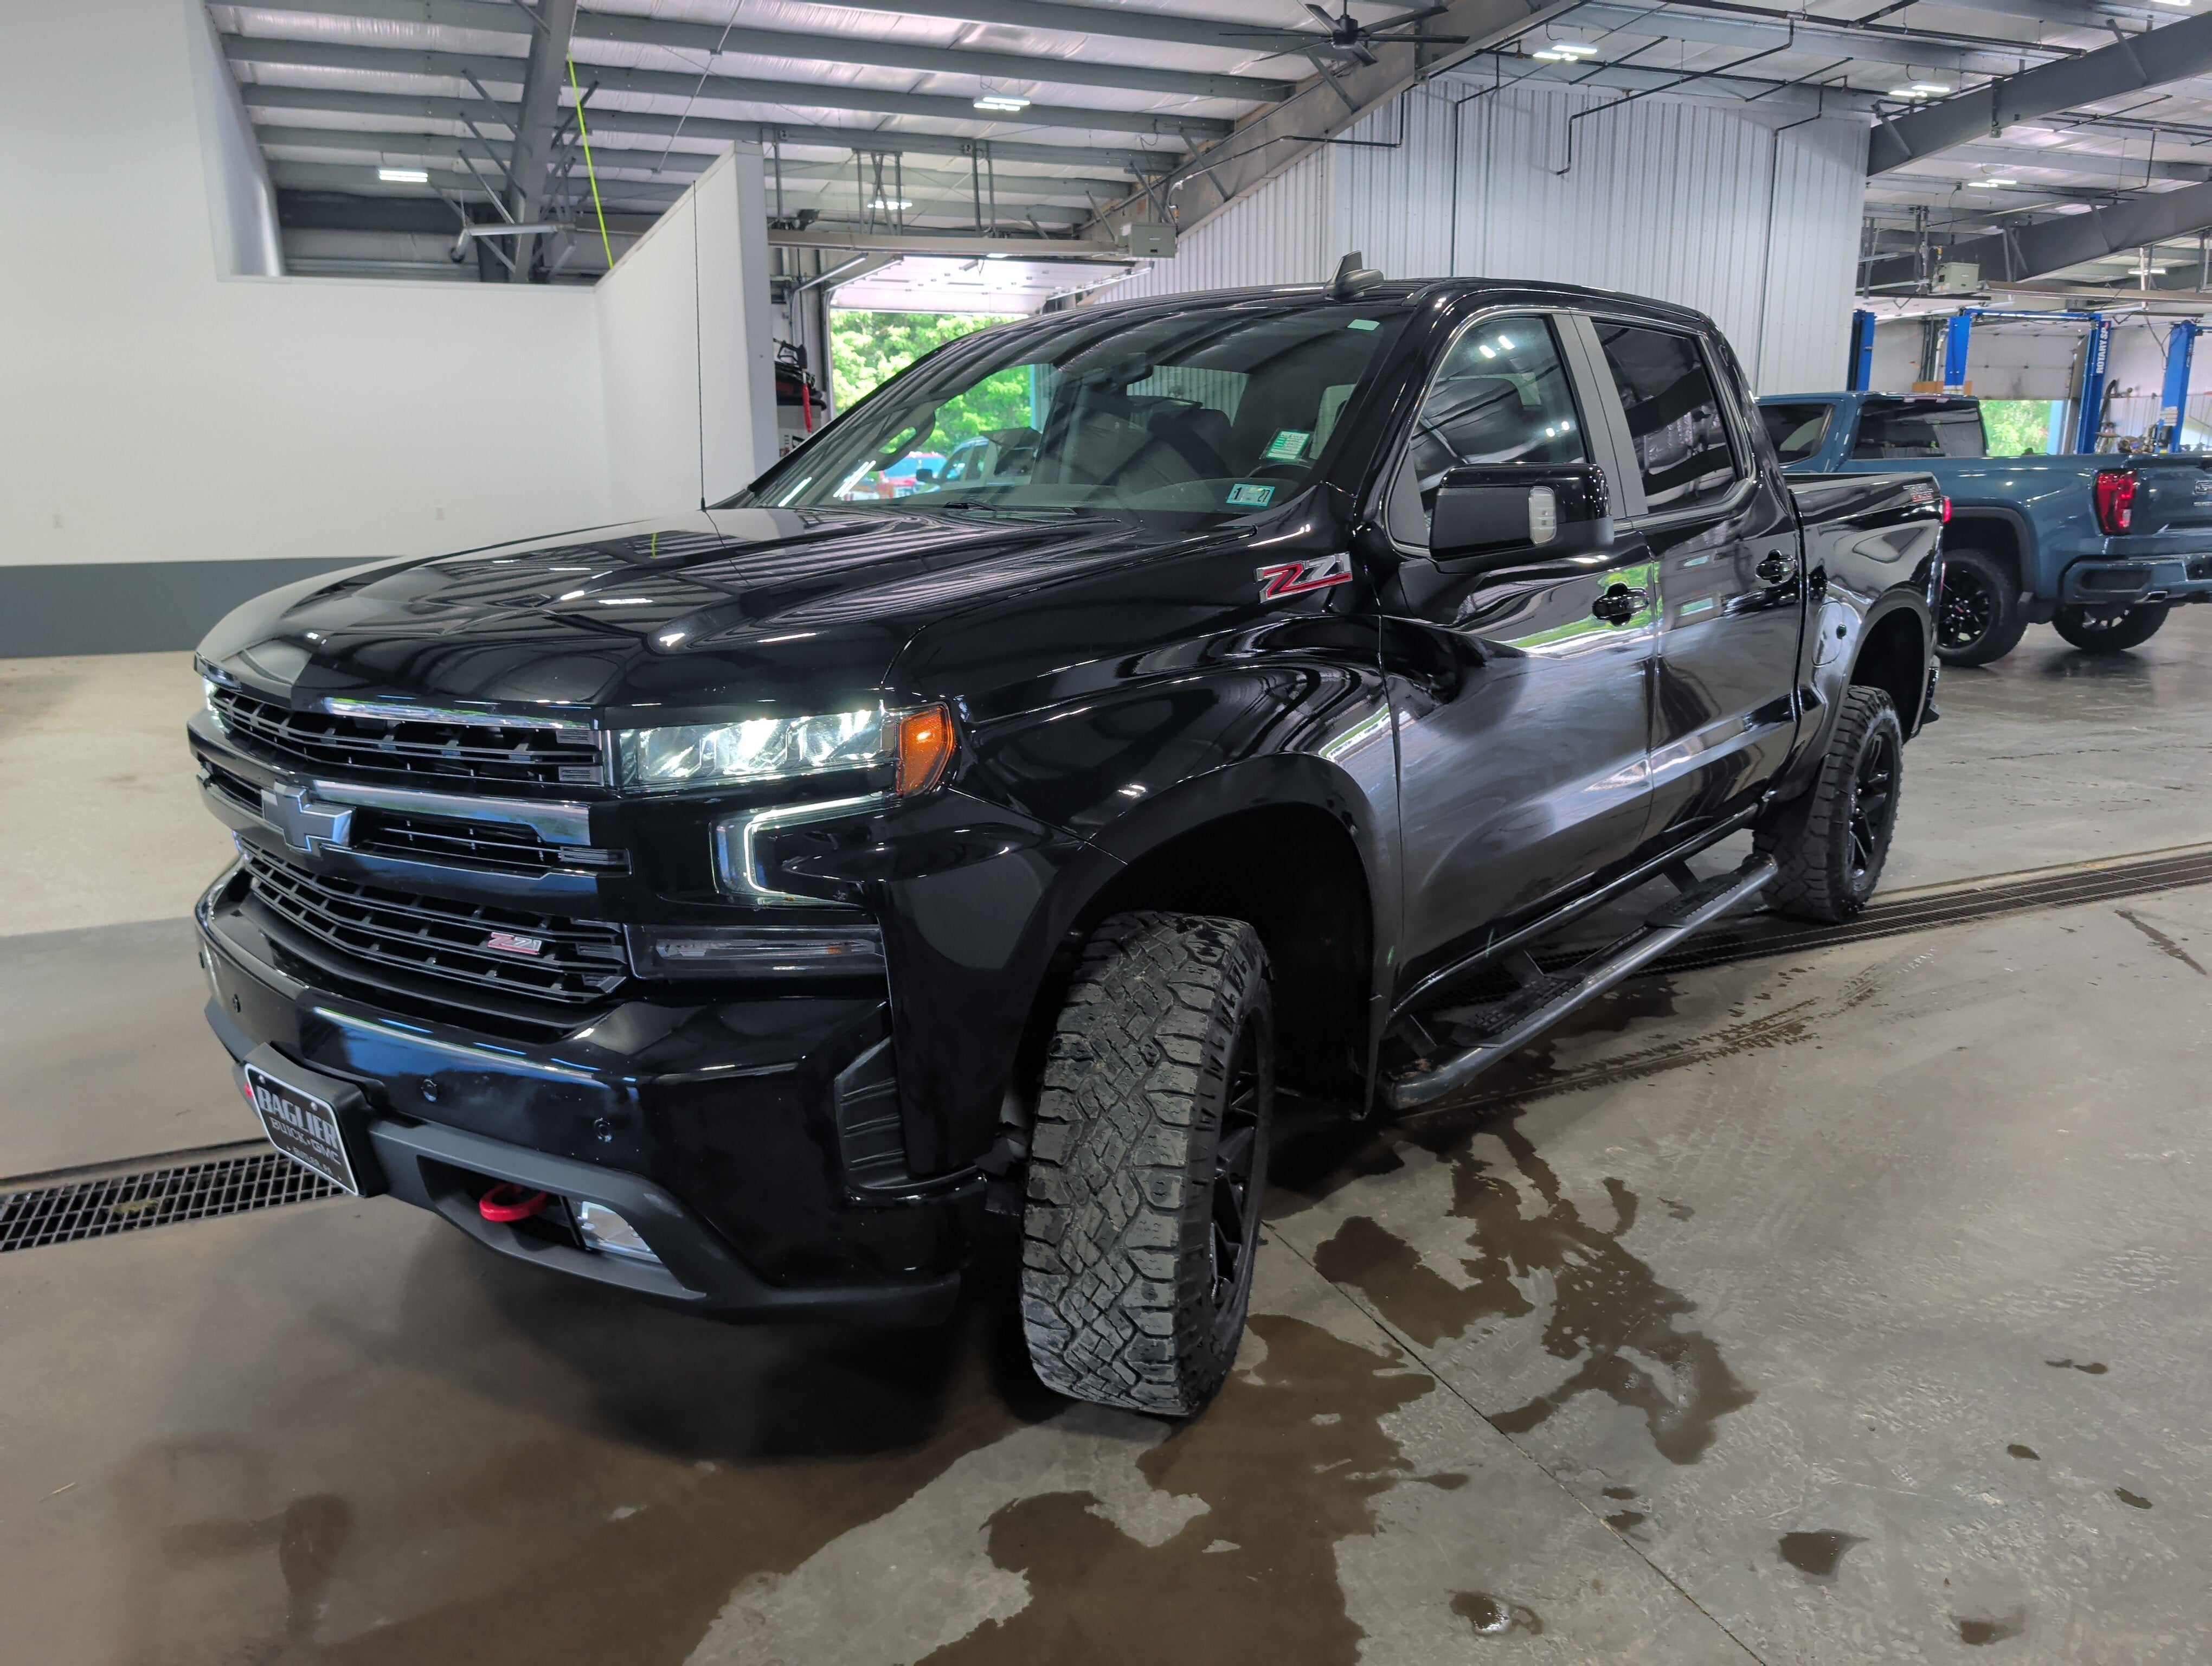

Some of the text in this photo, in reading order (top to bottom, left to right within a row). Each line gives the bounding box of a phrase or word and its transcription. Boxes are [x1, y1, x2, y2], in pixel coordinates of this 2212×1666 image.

[2096, 339, 2107, 374] ROTARY
[1257, 489, 1270, 502] 27
[1253, 551, 1353, 604] Z71
[487, 931, 542, 955] Z71
[256, 1085, 339, 1150] BAGLIER
